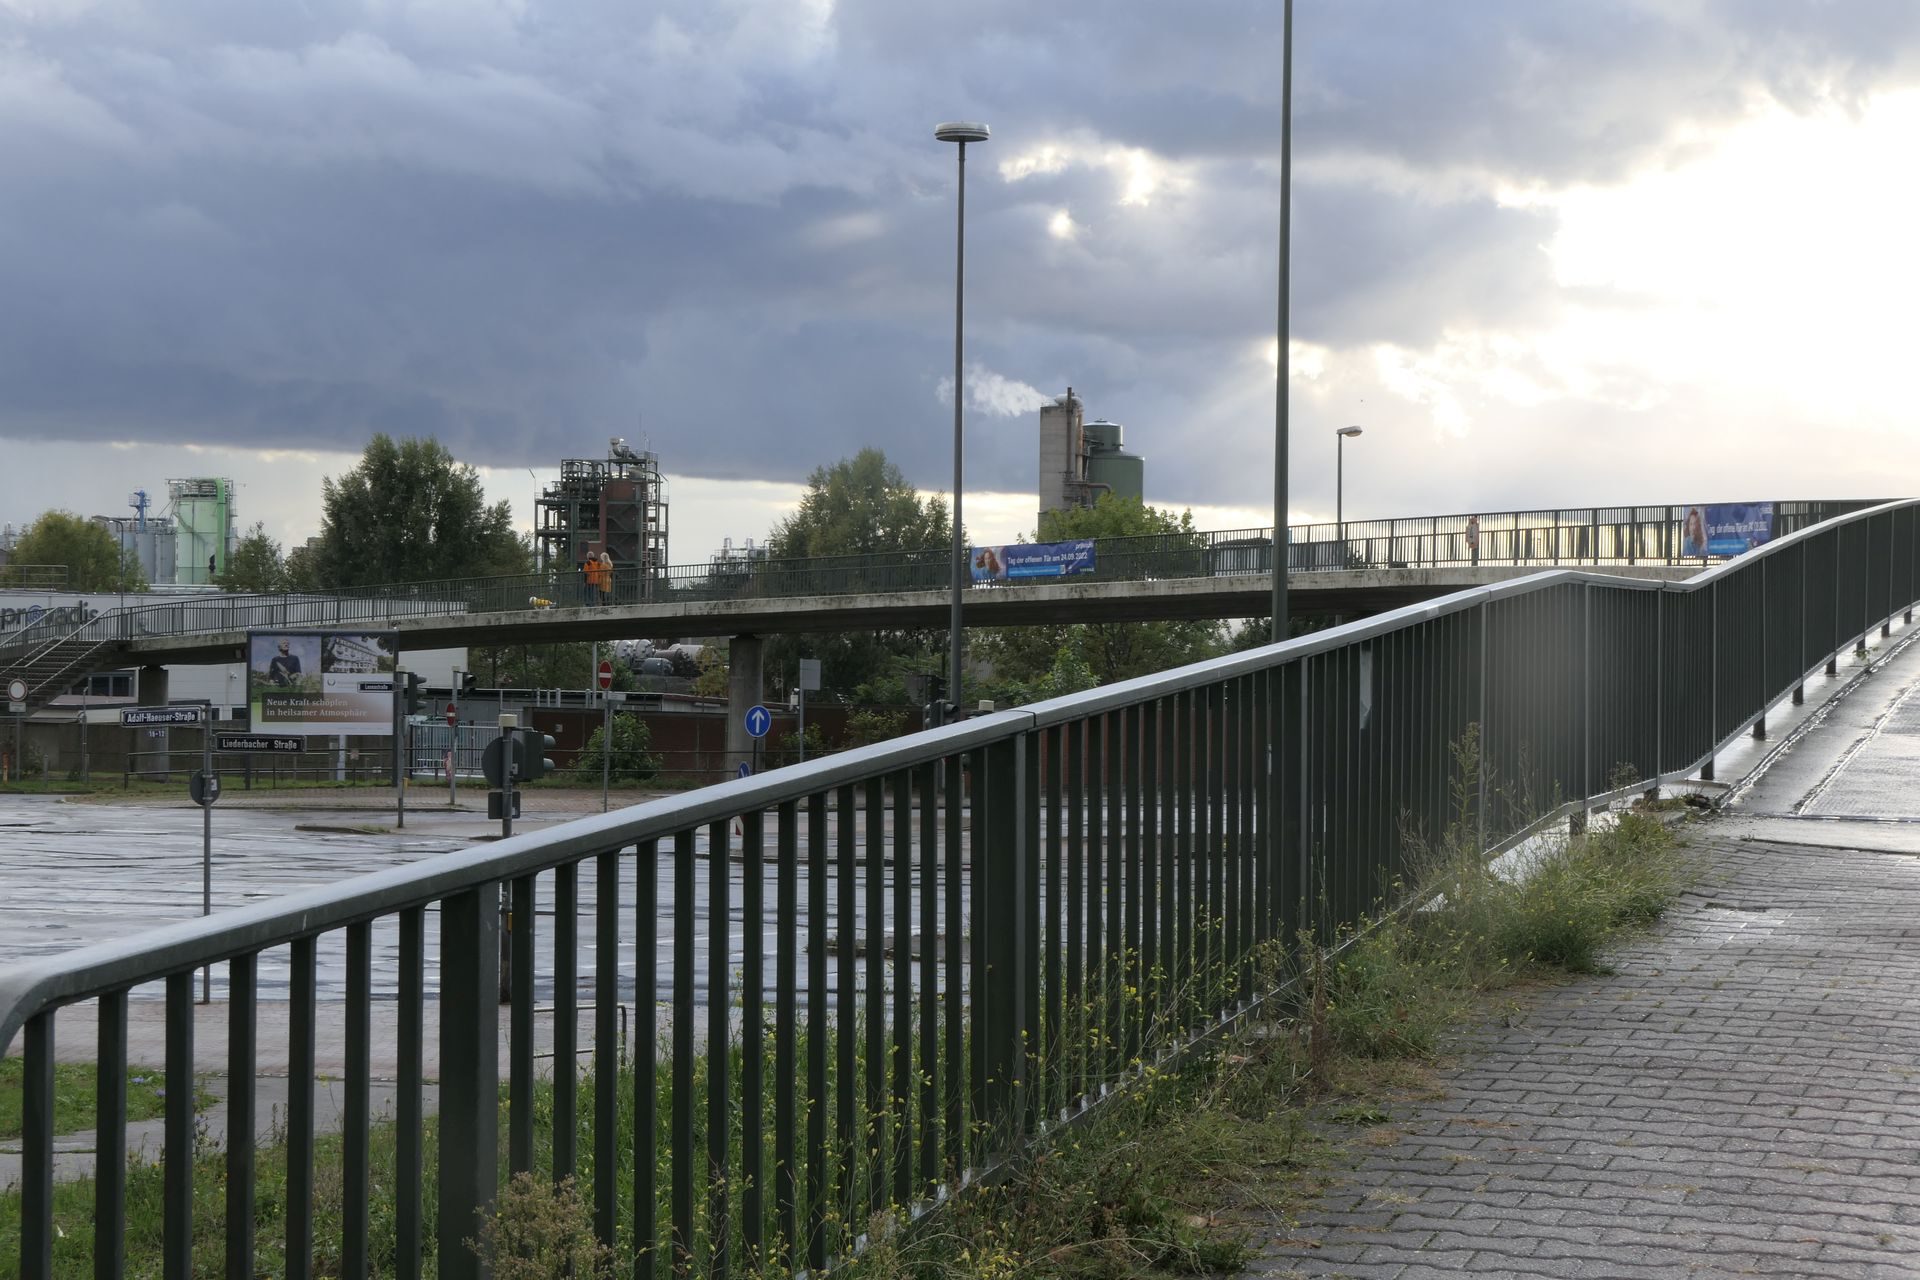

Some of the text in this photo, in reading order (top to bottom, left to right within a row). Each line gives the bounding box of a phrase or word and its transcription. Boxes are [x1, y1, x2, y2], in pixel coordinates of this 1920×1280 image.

[267, 698, 287, 706] Neue
[290, 698, 309, 706] Kraft
[127, 711, 195, 723] Adolf-Haeuser-Straße
[267, 708, 368, 718] in heilsamer Atmosphäre
[222, 738, 298, 750] Liederbacher Straße
